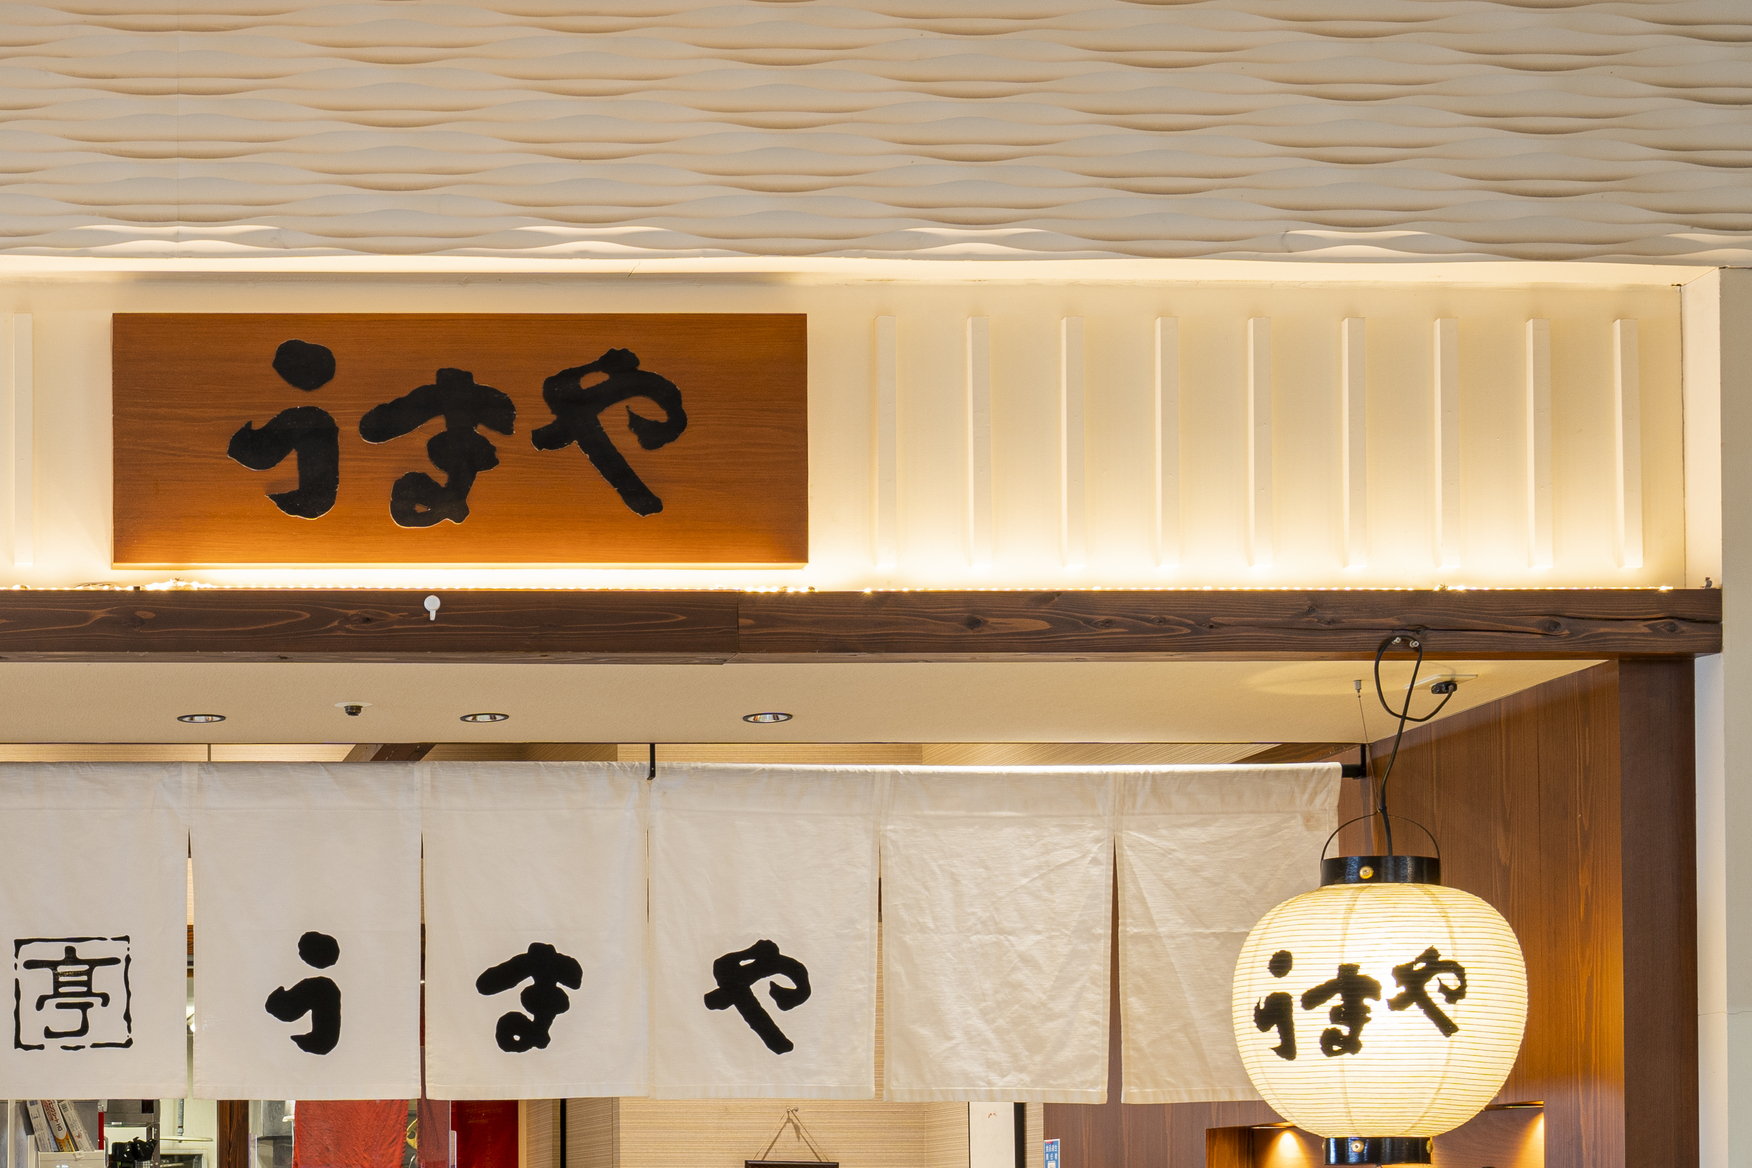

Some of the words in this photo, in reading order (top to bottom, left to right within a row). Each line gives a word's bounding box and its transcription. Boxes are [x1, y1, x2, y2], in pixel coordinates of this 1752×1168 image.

[227, 339, 688, 529] うまや
[264, 930, 812, 1056] うまや
[1253, 944, 1468, 1061] うまや
